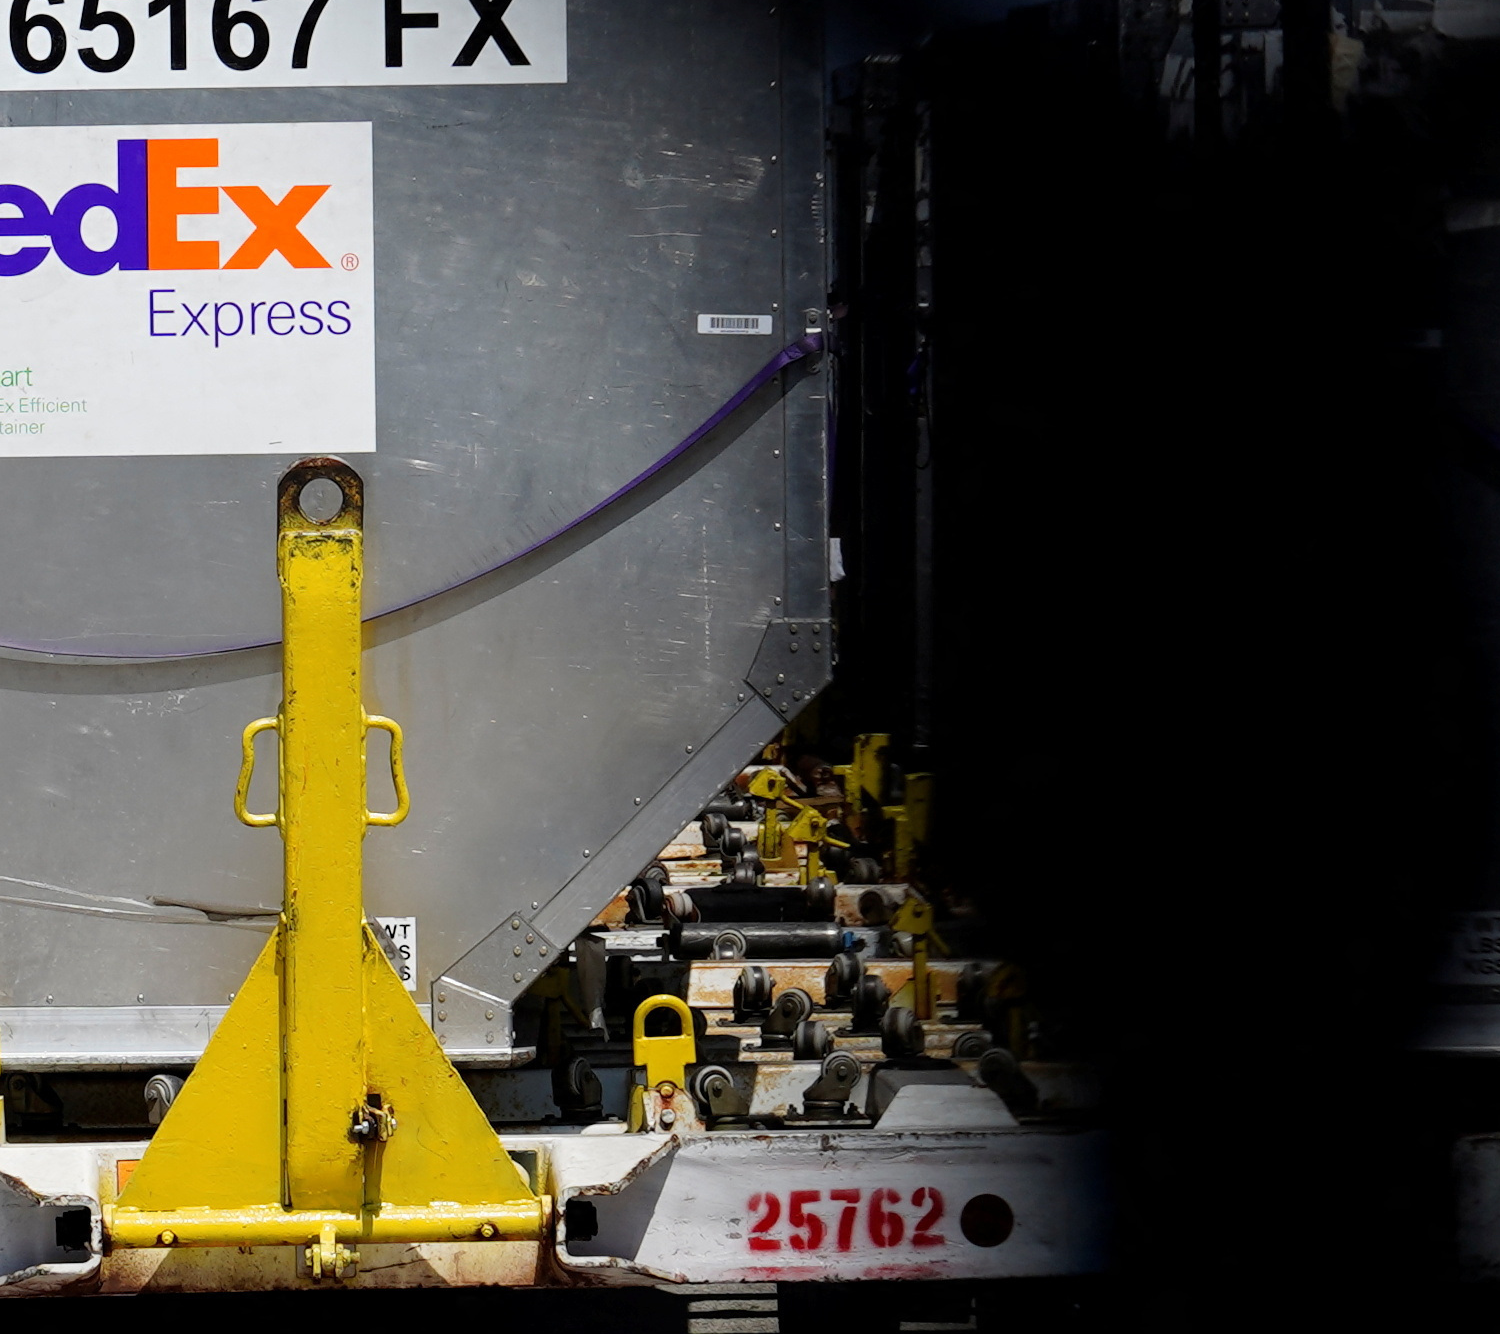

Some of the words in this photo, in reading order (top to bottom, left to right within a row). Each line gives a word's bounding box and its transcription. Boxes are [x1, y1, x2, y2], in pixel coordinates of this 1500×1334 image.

[148, 288, 352, 349] Express
[19, 397, 88, 414] Efficient
[746, 1186, 947, 1252] 25762
